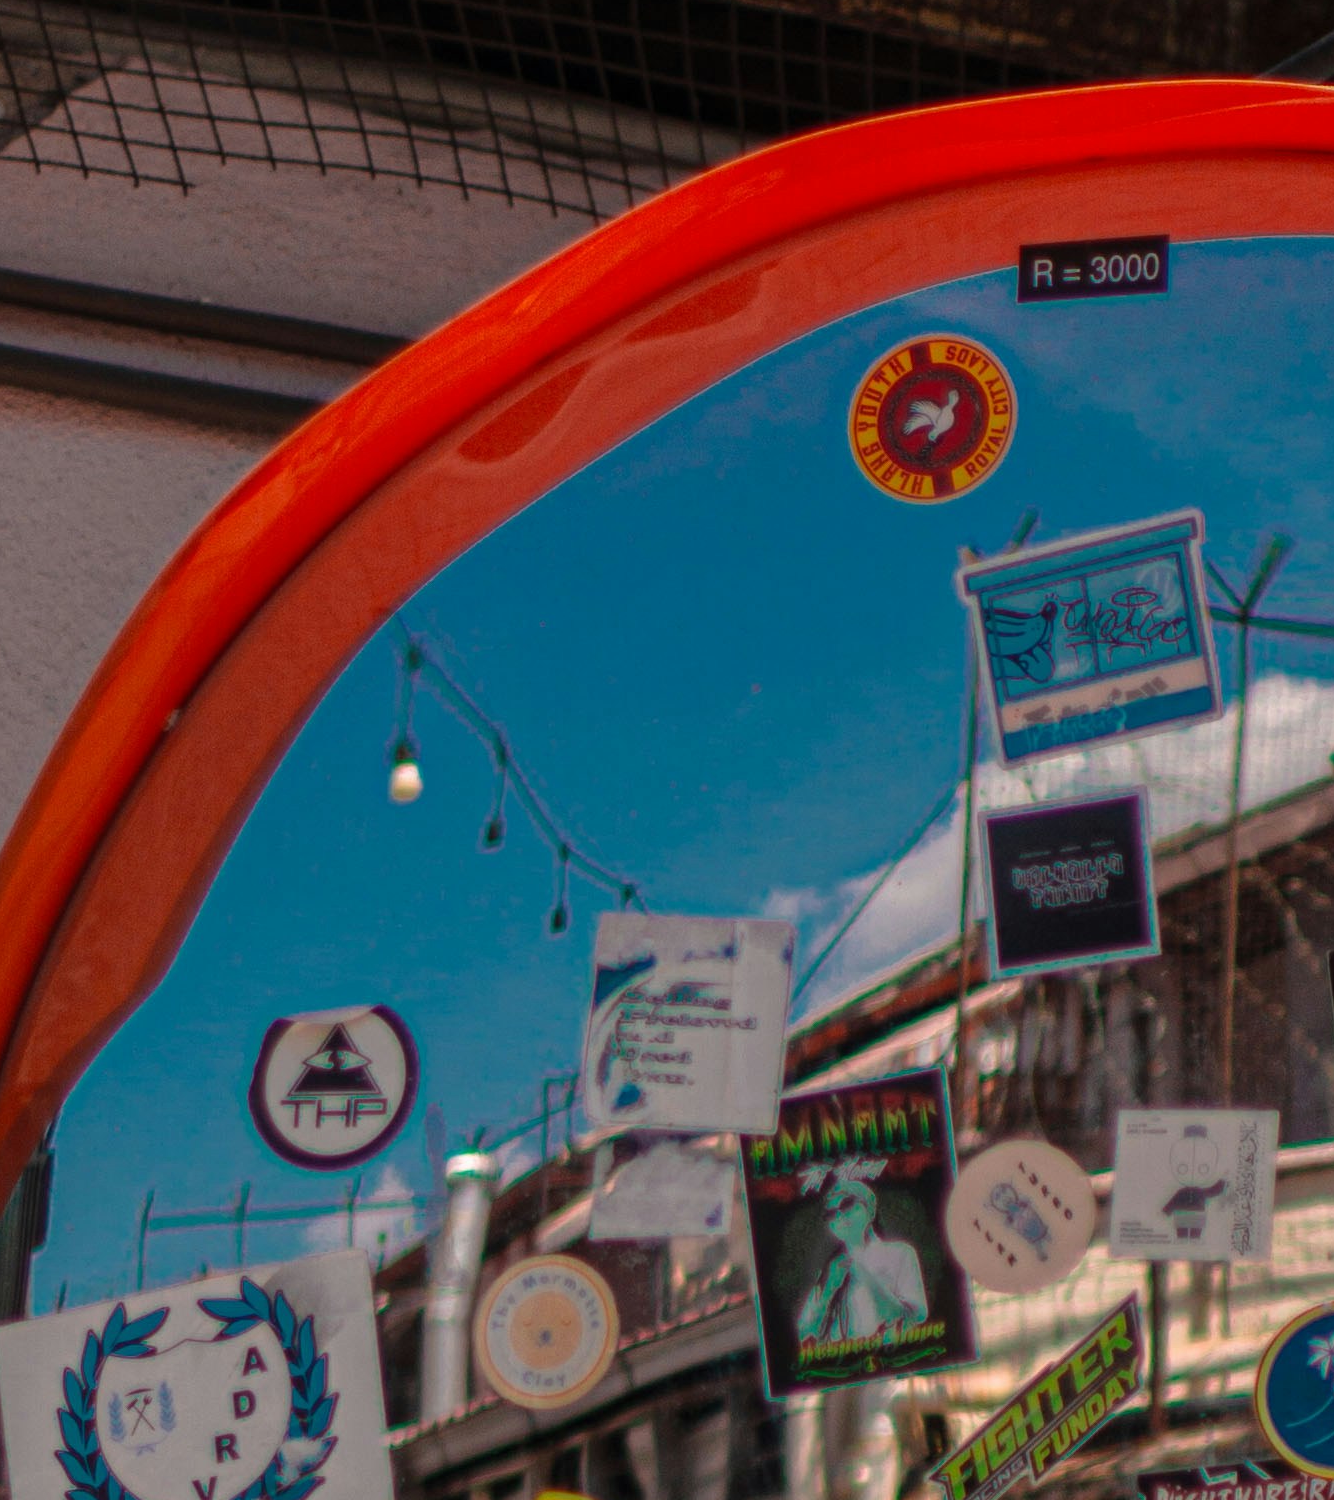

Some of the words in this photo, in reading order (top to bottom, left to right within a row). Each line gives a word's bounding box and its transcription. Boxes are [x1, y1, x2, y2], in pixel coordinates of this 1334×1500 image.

[1033, 260, 1054, 288] R
[1089, 252, 1160, 285] 3000
[280, 1097, 389, 1129] THP
[1030, 1355, 1139, 1473] FUNDAY
